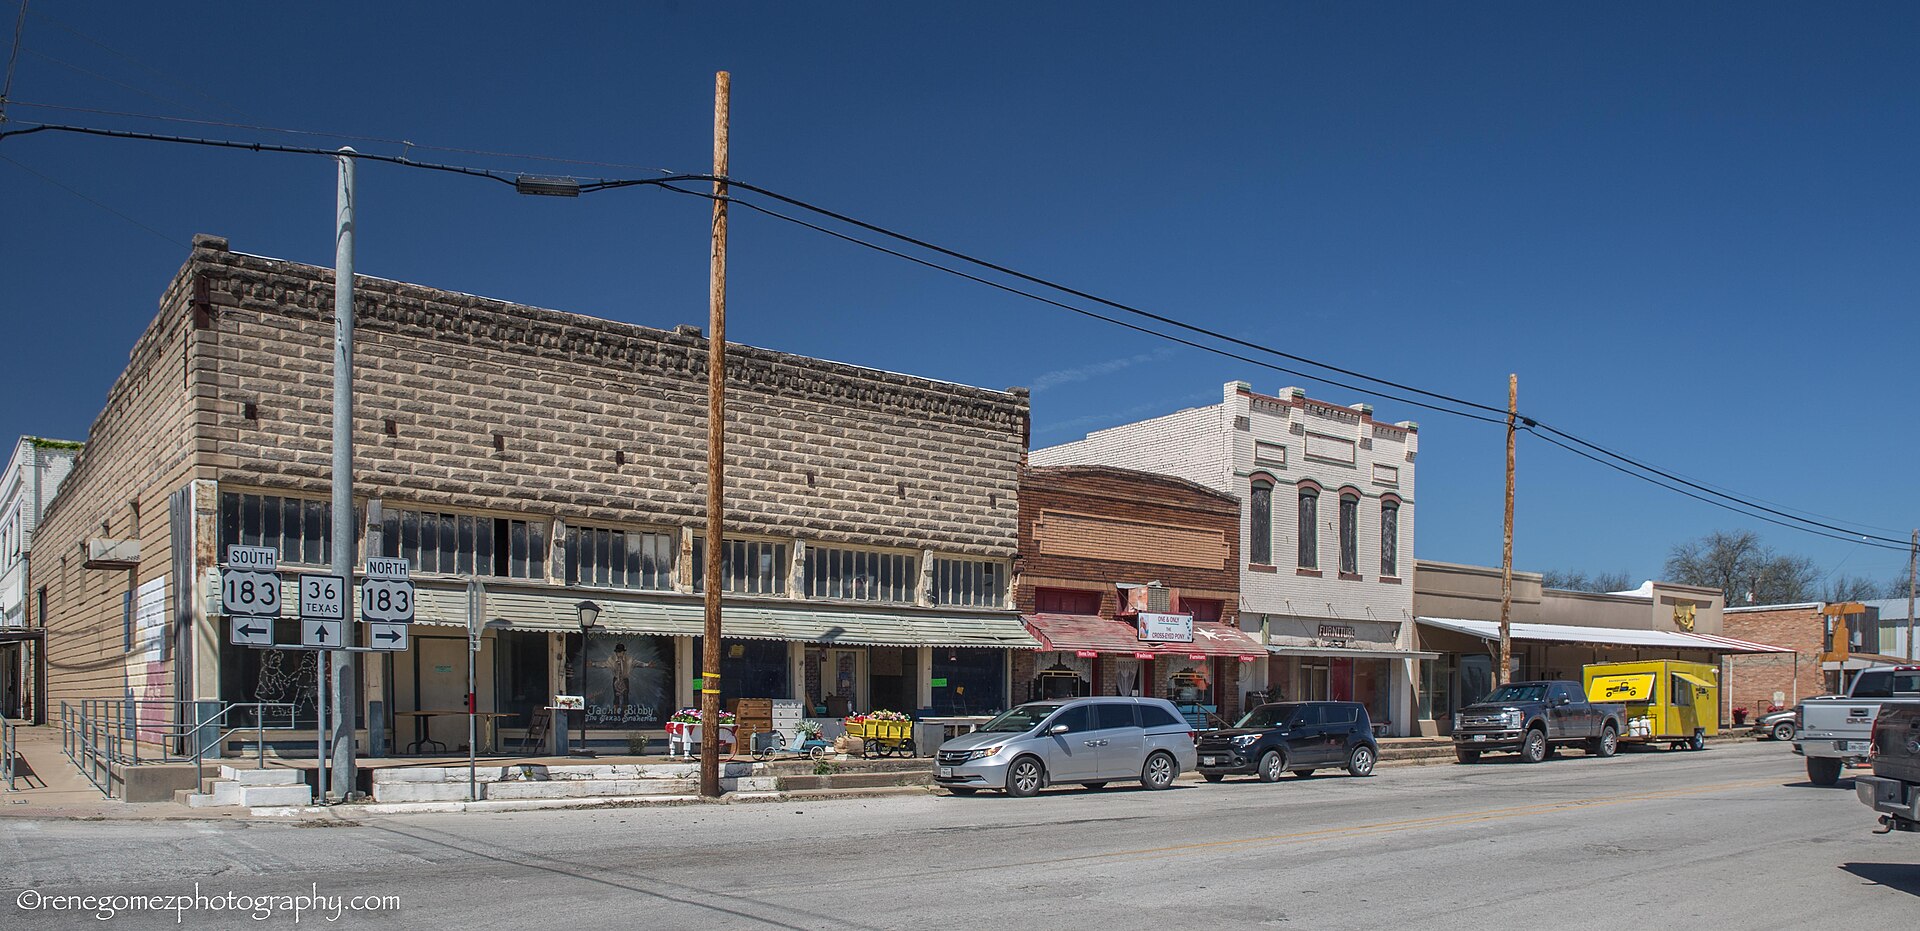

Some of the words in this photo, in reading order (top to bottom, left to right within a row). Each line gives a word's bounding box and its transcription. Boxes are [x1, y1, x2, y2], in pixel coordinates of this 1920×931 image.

[232, 550, 274, 565] SOUTH
[369, 561, 407, 576] NORTH
[228, 580, 276, 605] 183
[308, 581, 336, 600] 36
[306, 602, 338, 613] TEXAS
[366, 588, 409, 613] 183
[1318, 625, 1355, 638] FURNITURE
[587, 704, 622, 716] Jackie
[623, 704, 654, 716] Bibby
